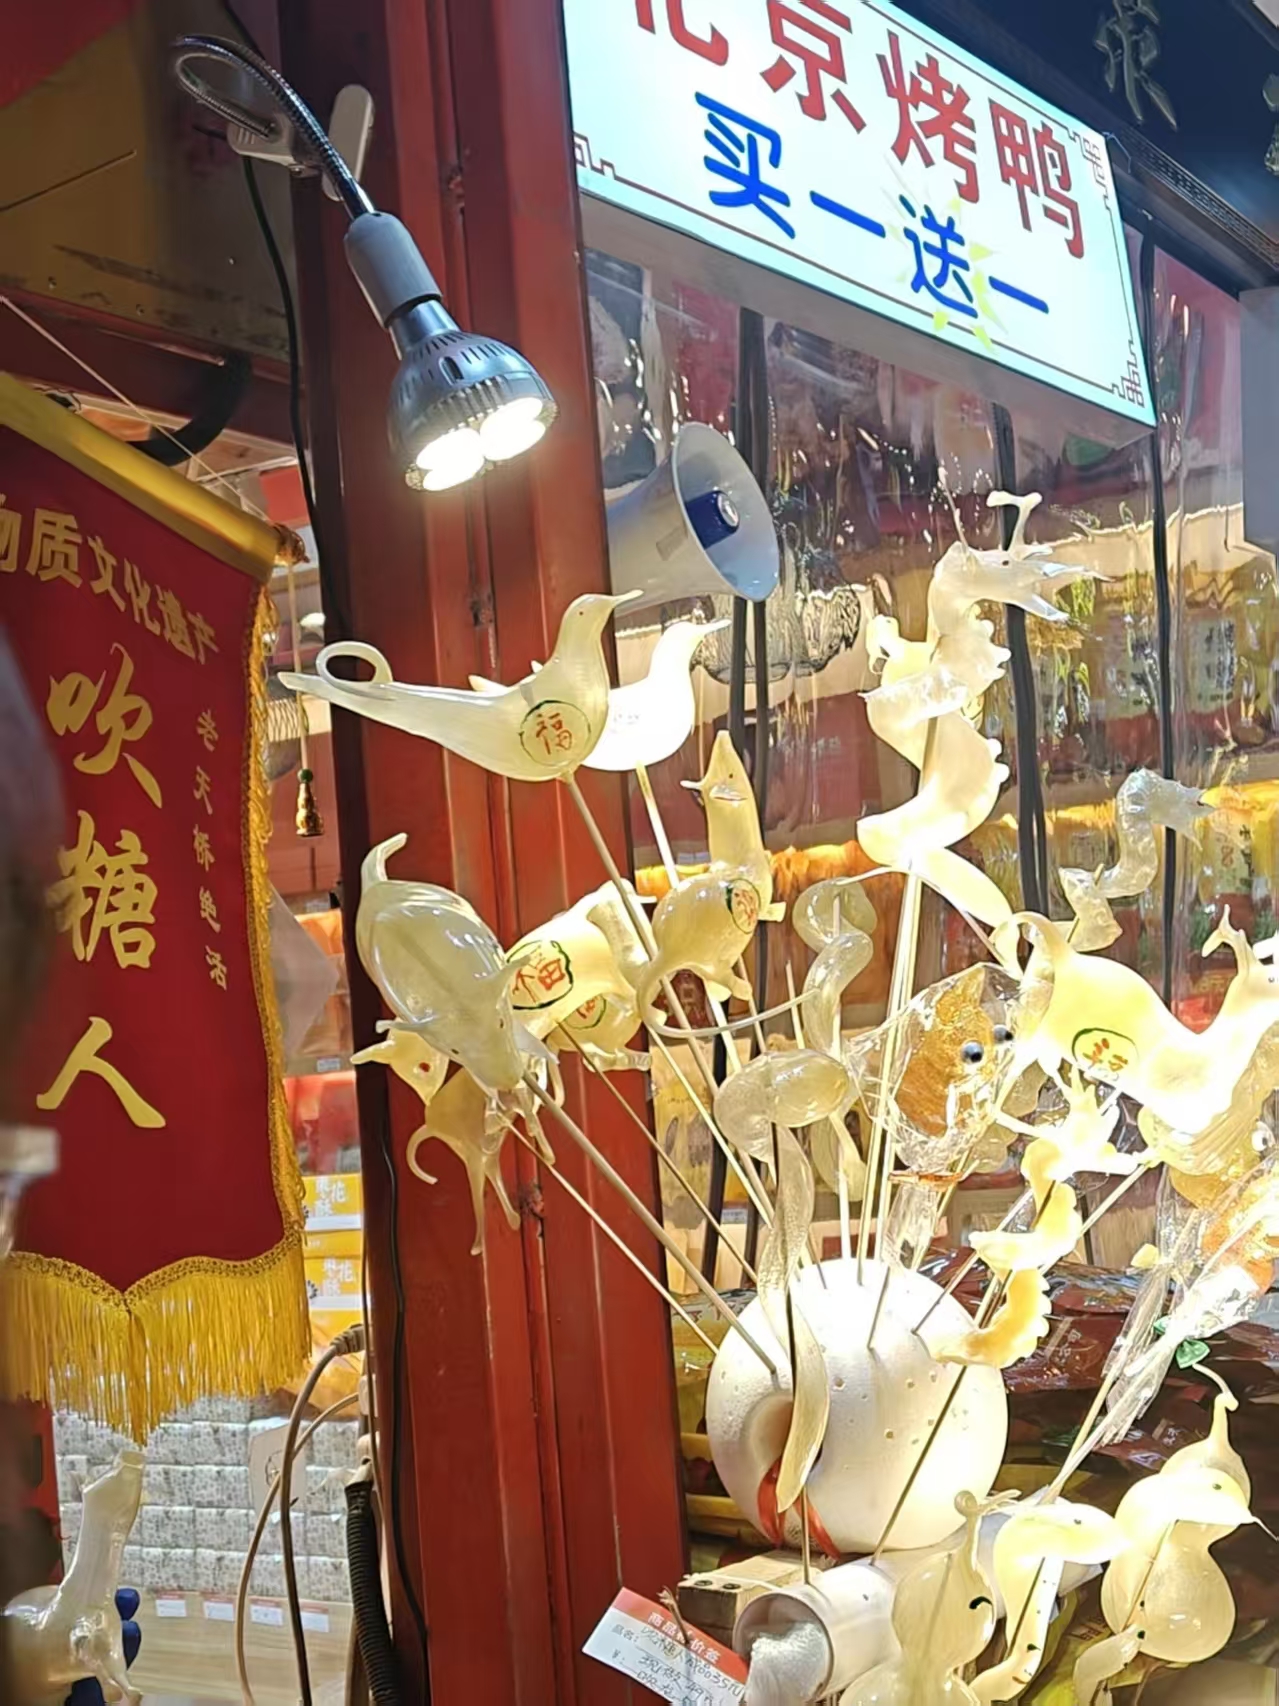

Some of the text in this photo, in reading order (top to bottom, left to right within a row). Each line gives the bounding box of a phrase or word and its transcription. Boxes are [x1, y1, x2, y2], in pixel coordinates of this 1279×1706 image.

[695, 91, 1049, 318] 买一送一
[536, 712, 572, 755] 福
[37, 642, 166, 1128] 吹糖人
